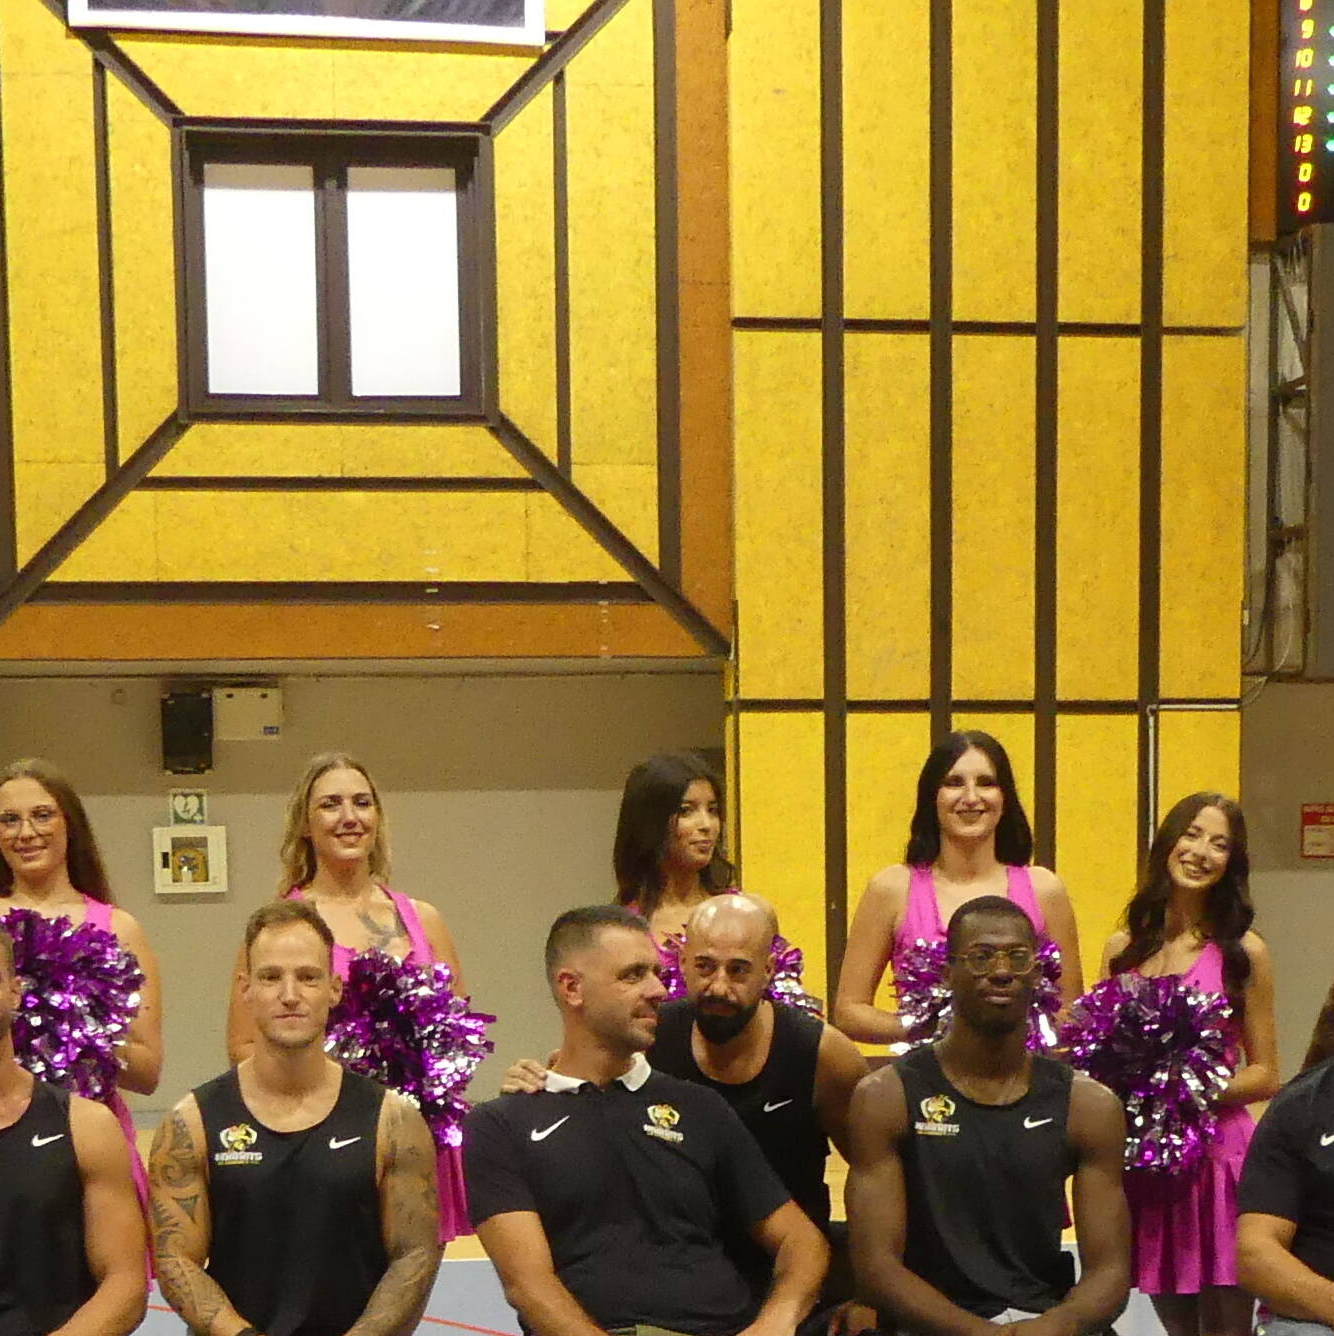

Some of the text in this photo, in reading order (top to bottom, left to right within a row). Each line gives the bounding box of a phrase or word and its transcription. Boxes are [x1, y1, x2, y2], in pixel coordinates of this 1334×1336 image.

[1301, 19, 1315, 39] 9
[1295, 48, 1314, 69] 10
[1294, 79, 1313, 97] 11
[1294, 133, 1314, 154] 13
[1298, 162, 1312, 182] 0
[1297, 192, 1312, 212] 0
